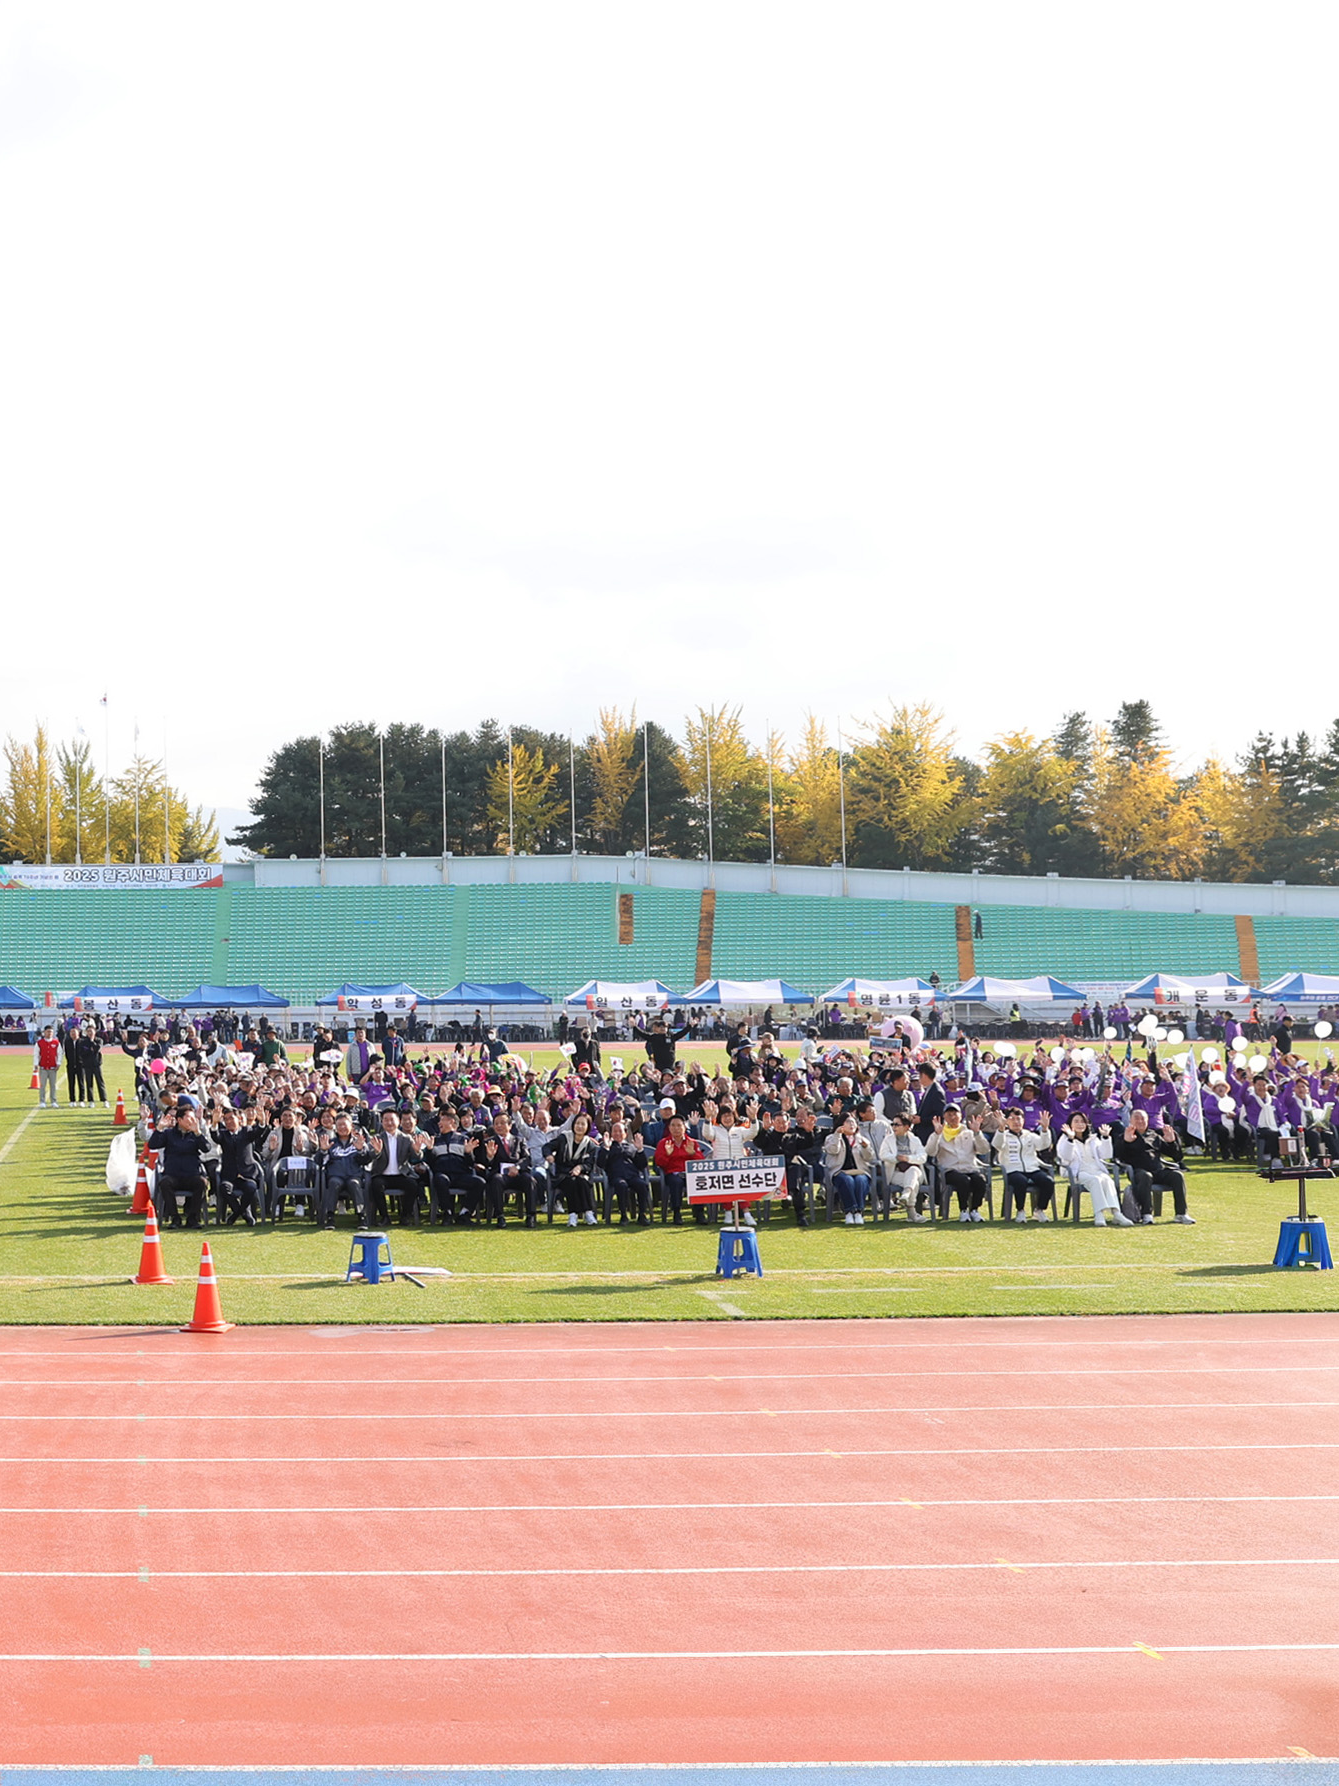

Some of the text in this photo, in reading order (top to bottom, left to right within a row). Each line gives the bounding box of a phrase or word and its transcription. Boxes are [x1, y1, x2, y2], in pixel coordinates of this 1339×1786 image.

[64, 869, 99, 882] 2025
[103, 867, 212, 882] 원주시민체육대회
[692, 1158, 779, 1171] 2025 원주시민체육대회
[695, 1172, 777, 1191] 호저면 선수단
